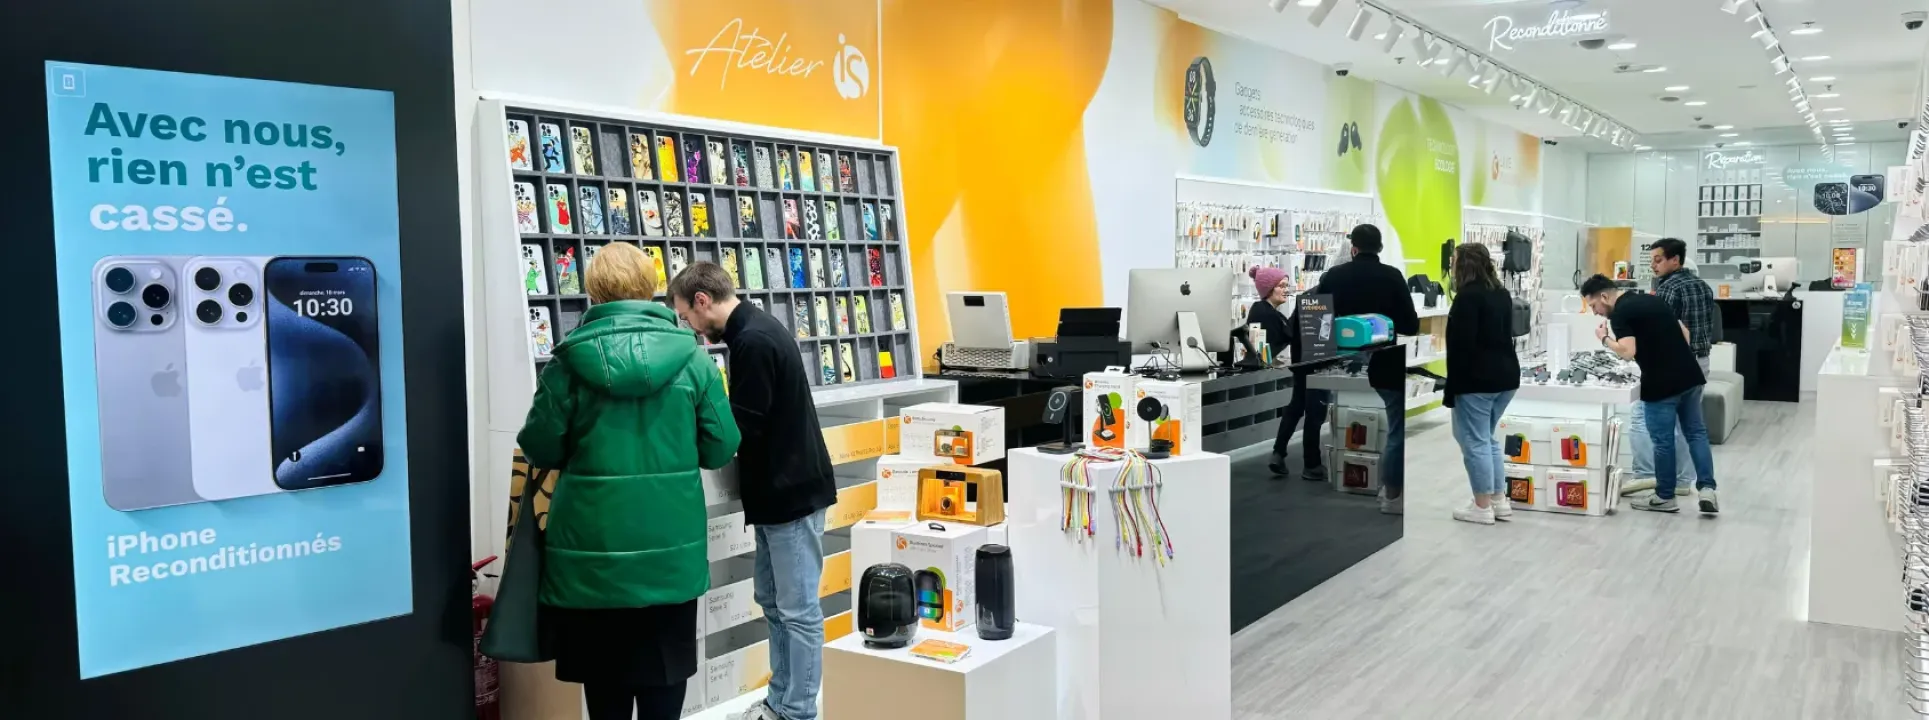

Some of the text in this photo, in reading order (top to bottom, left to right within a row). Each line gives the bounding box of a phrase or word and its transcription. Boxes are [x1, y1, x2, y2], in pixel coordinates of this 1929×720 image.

[1483, 10, 1608, 52] Reconditionné
[84, 102, 345, 156] Avec nous,
[88, 147, 318, 190] rien n’est
[90, 197, 248, 232] cassé.
[293, 298, 353, 317] 10:30
[107, 528, 216, 558] iPhone
[110, 533, 342, 586] Reconditionnés
